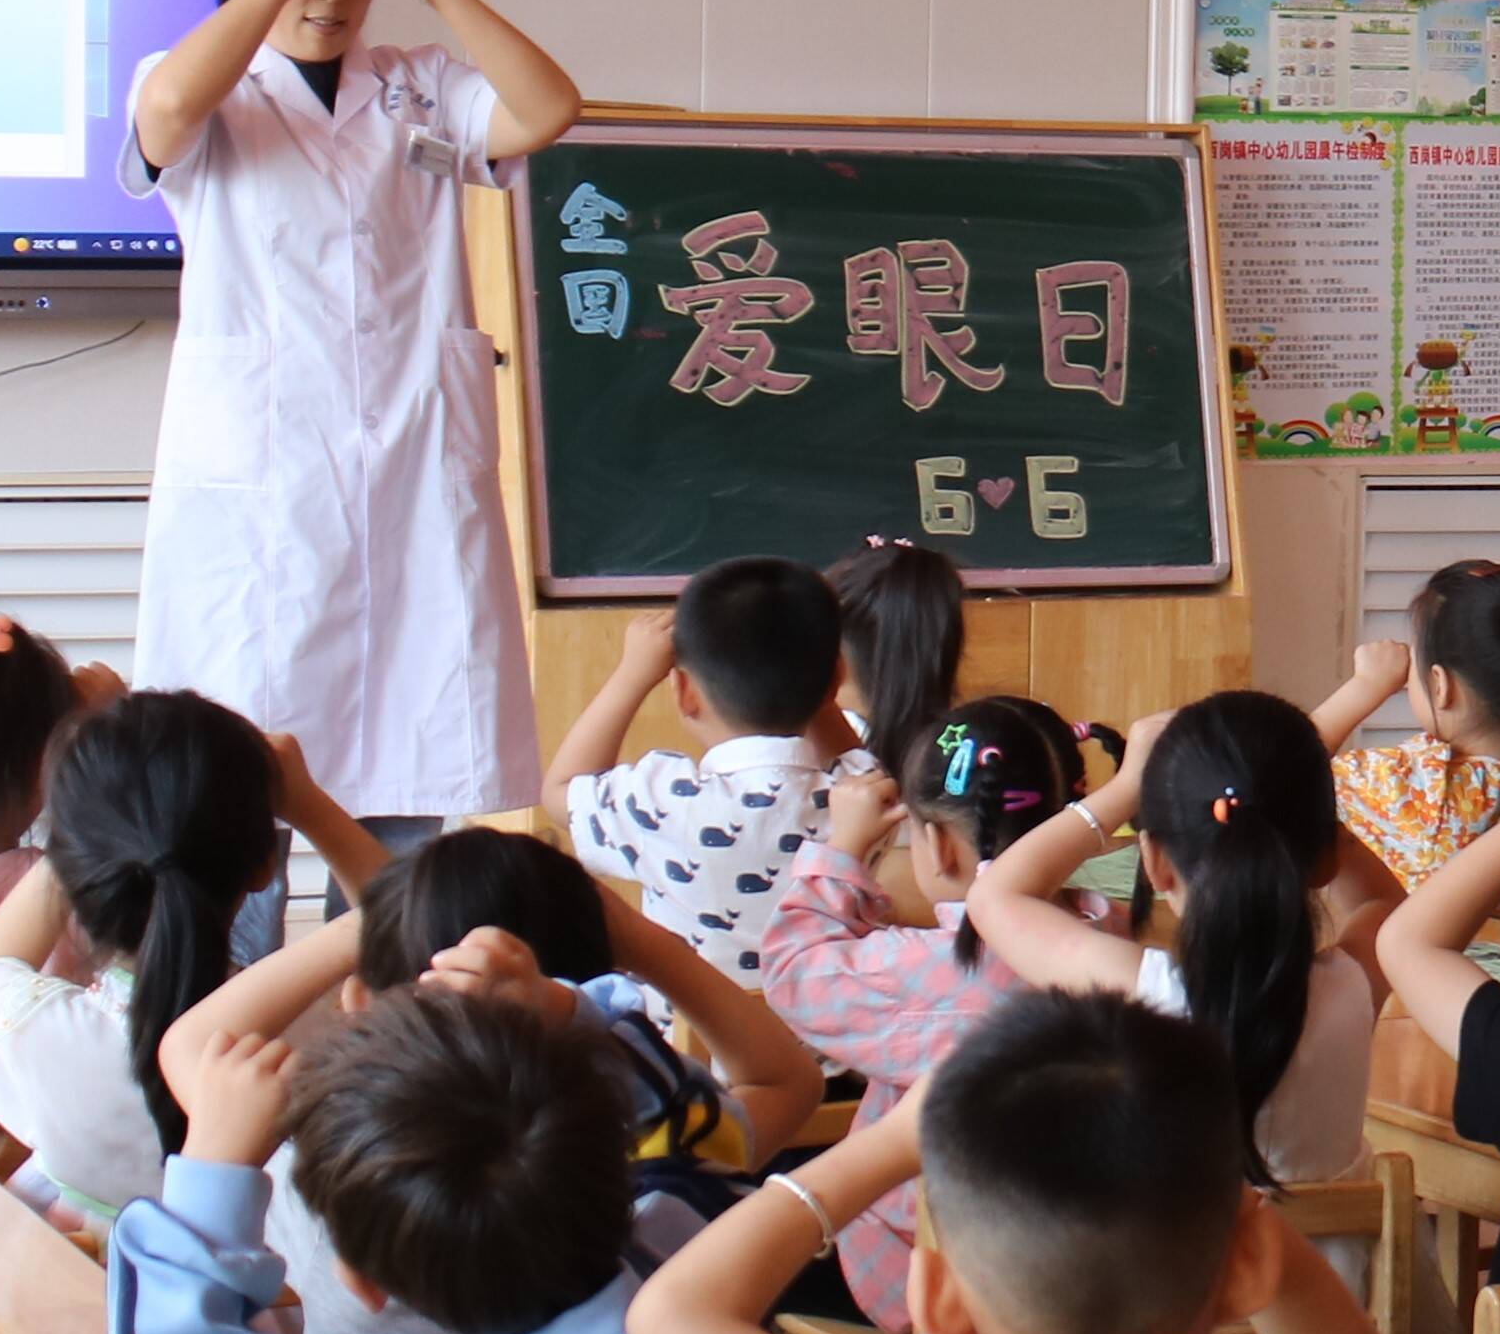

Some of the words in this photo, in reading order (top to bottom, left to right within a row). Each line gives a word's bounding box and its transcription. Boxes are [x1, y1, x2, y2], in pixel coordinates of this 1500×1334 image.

[559, 181, 631, 340] 全国
[657, 210, 1132, 412] 爱眼日
[915, 455, 975, 536] 6
[1025, 454, 1088, 539] 6
